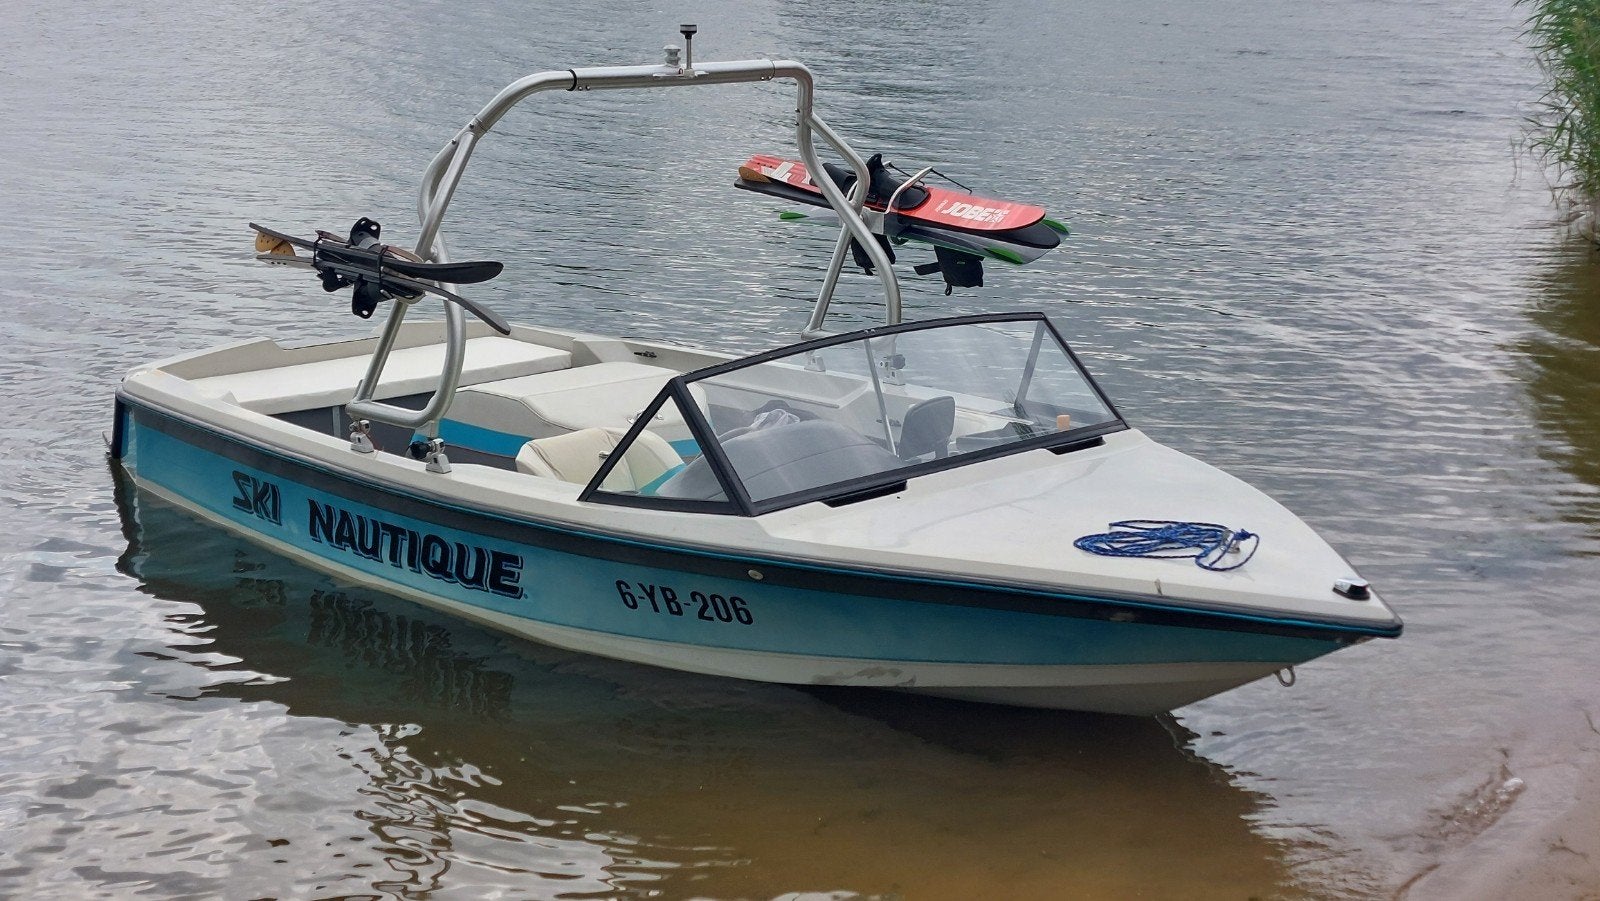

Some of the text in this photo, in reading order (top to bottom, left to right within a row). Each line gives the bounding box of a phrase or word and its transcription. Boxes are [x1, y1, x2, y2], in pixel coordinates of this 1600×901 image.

[941, 201, 997, 222] JOBE
[232, 470, 525, 600] SKI NAUTIQUE
[615, 579, 754, 625] 6-YB-206
